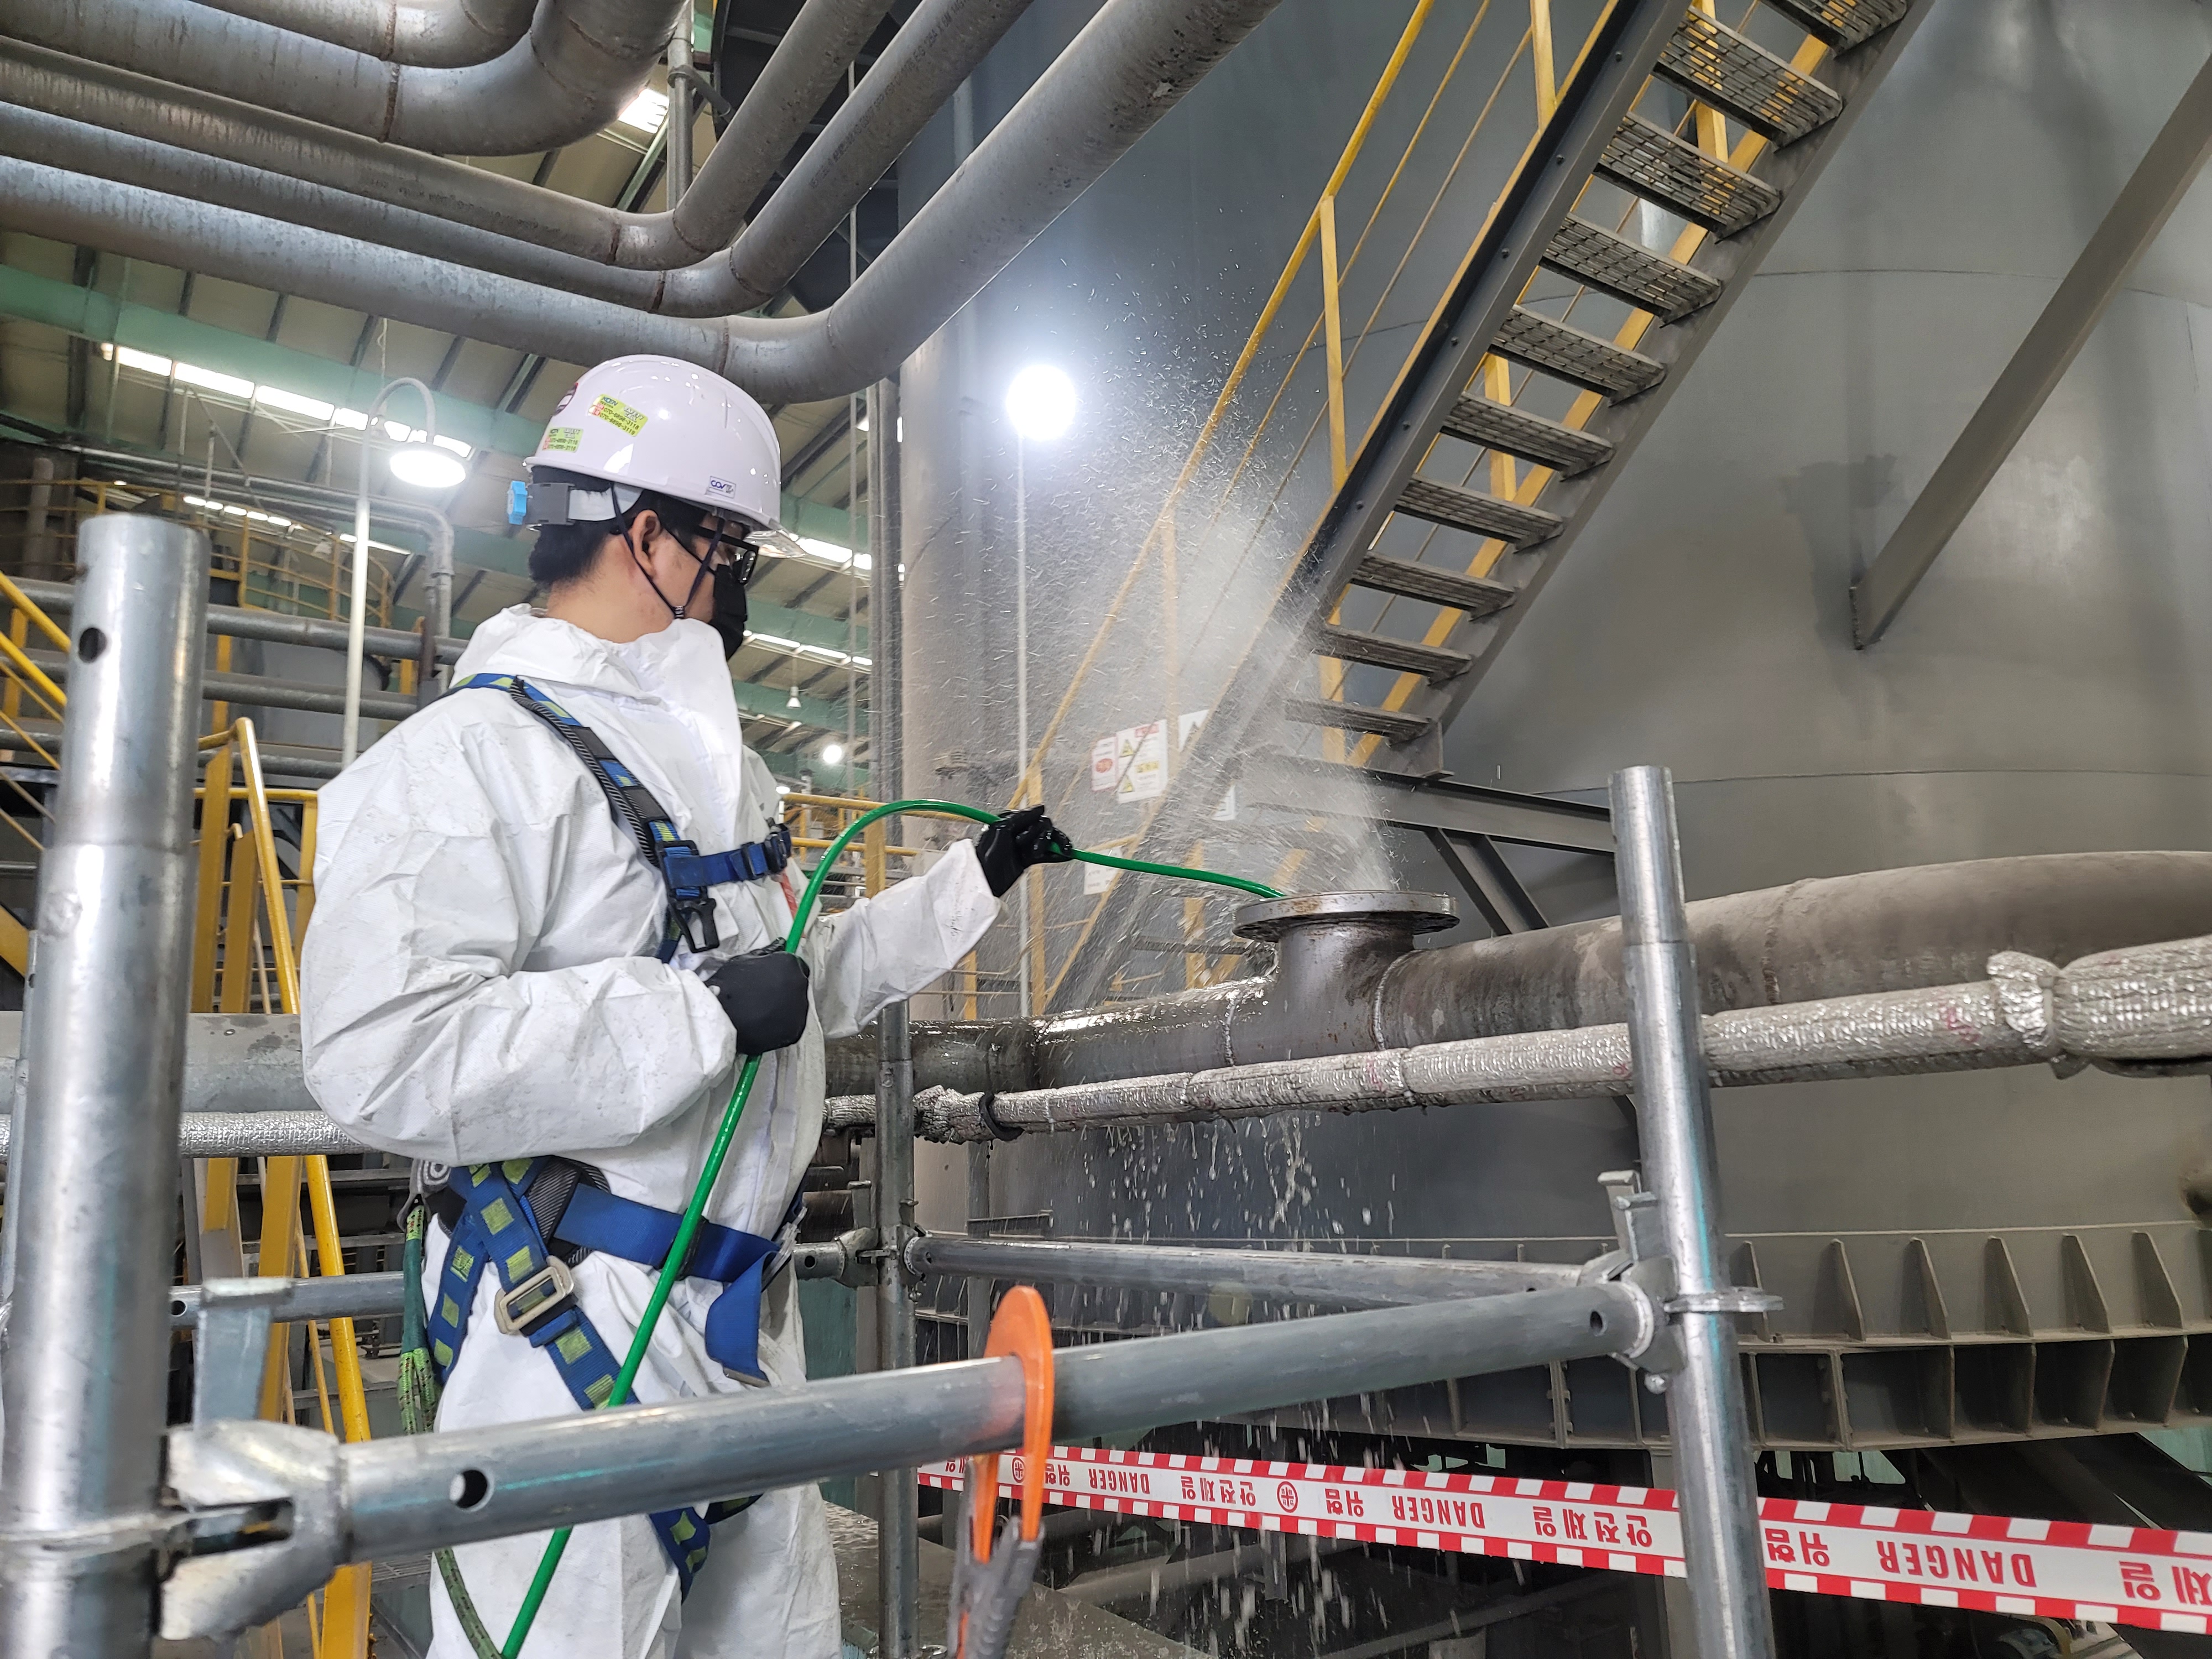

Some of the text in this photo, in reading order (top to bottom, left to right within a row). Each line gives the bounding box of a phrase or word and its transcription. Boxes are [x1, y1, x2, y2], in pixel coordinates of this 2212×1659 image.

[1045, 1464, 1071, 1487] 위험
[1088, 1468, 1150, 1495] DANGER
[1180, 1475, 1256, 1507] 안전제일
[1324, 1488, 1364, 1518] 위험
[1391, 1495, 1486, 1529] DANGER
[1533, 1506, 1652, 1548] 안전제일
[1765, 1528, 1831, 1567] 위험
[1876, 1540, 2038, 1588] DANGER
